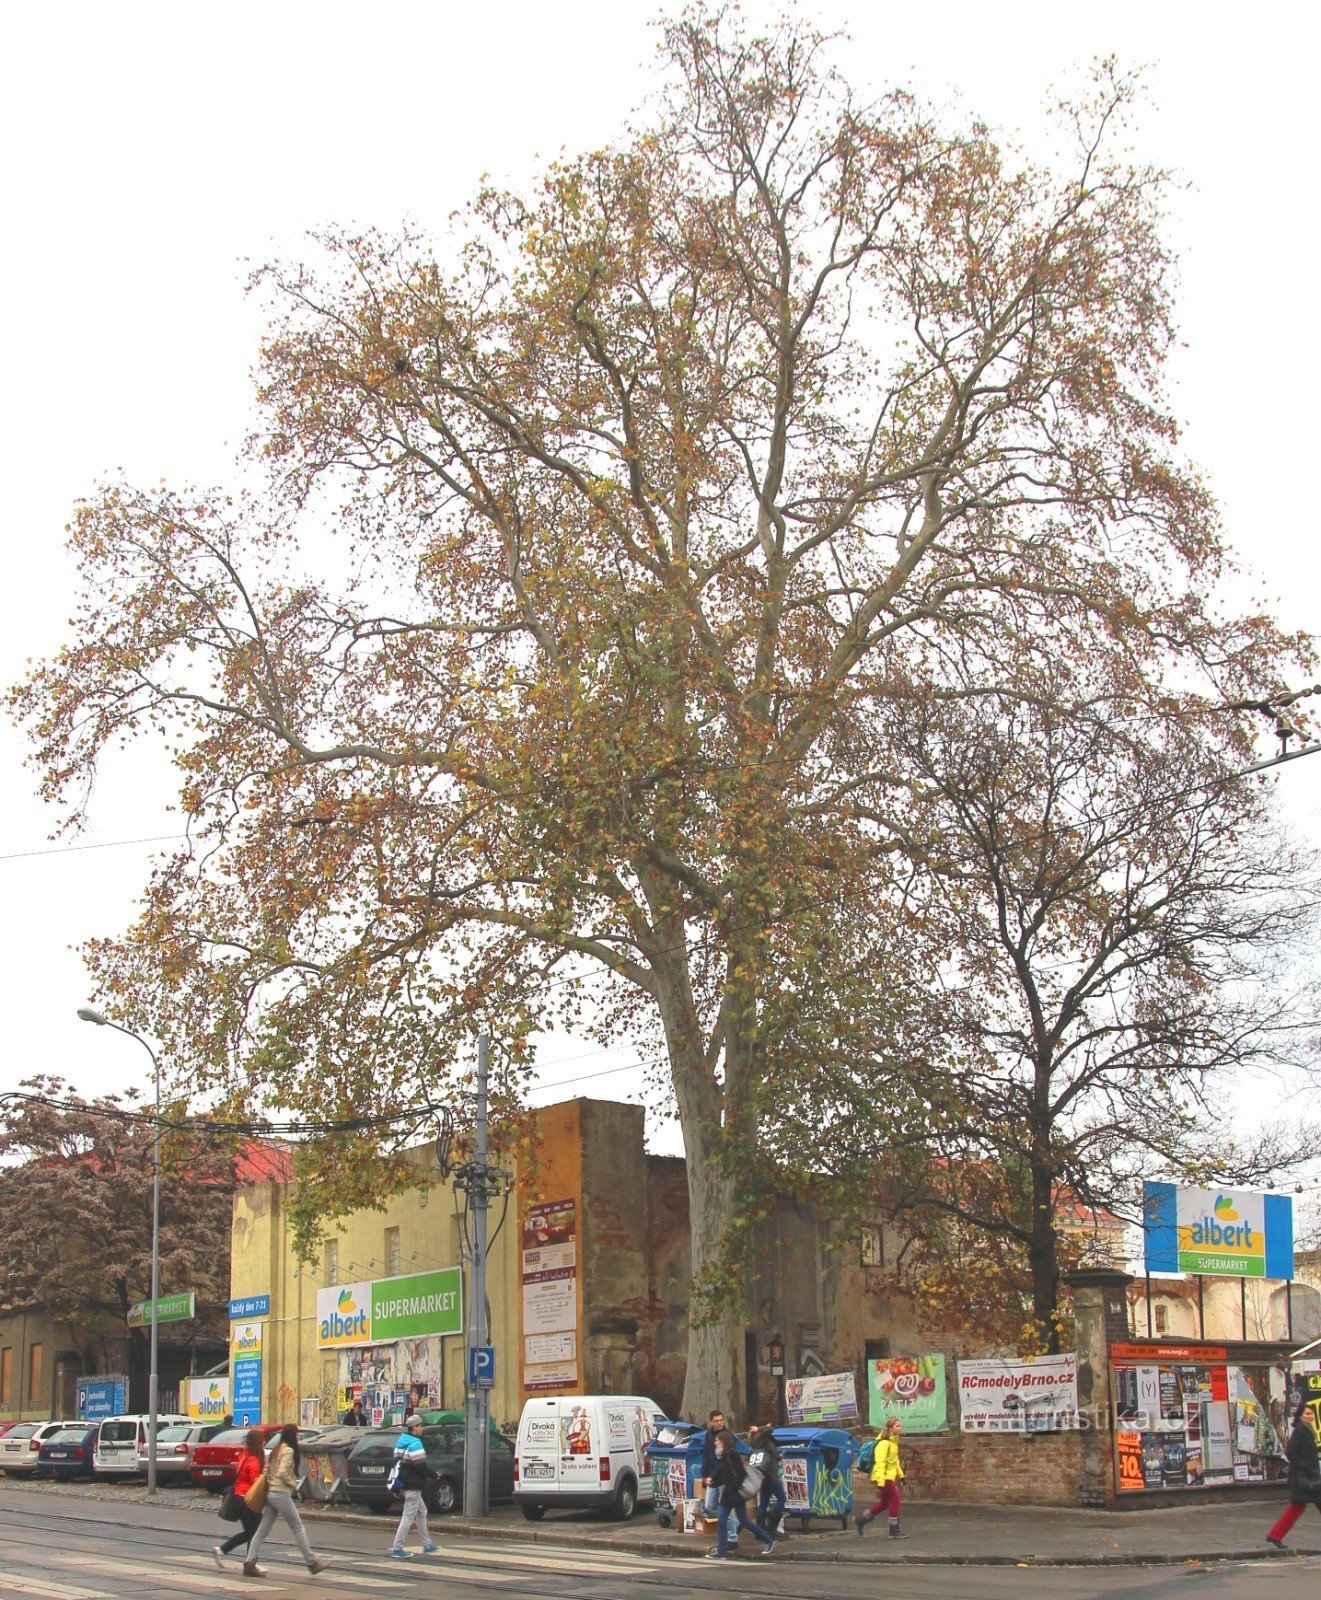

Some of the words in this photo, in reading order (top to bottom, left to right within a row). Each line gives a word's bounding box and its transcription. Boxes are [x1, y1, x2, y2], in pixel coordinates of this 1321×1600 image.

[1191, 1217, 1252, 1248] albert
[1198, 1258, 1248, 1270] SUPERMARKET
[231, 1302, 244, 1314] každý
[246, 1302, 254, 1311] den
[255, 1300, 266, 1310] 7-21
[321, 1309, 366, 1339] albert
[375, 1292, 456, 1319] SUPERMARKET
[238, 1336, 257, 1348] albert
[474, 1352, 490, 1376] P
[961, 1373, 1074, 1389] RCmodelyBrno.cz
[198, 1397, 226, 1415] albert
[531, 1422, 555, 1430] Divoká
[749, 1452, 764, 1465] 99
